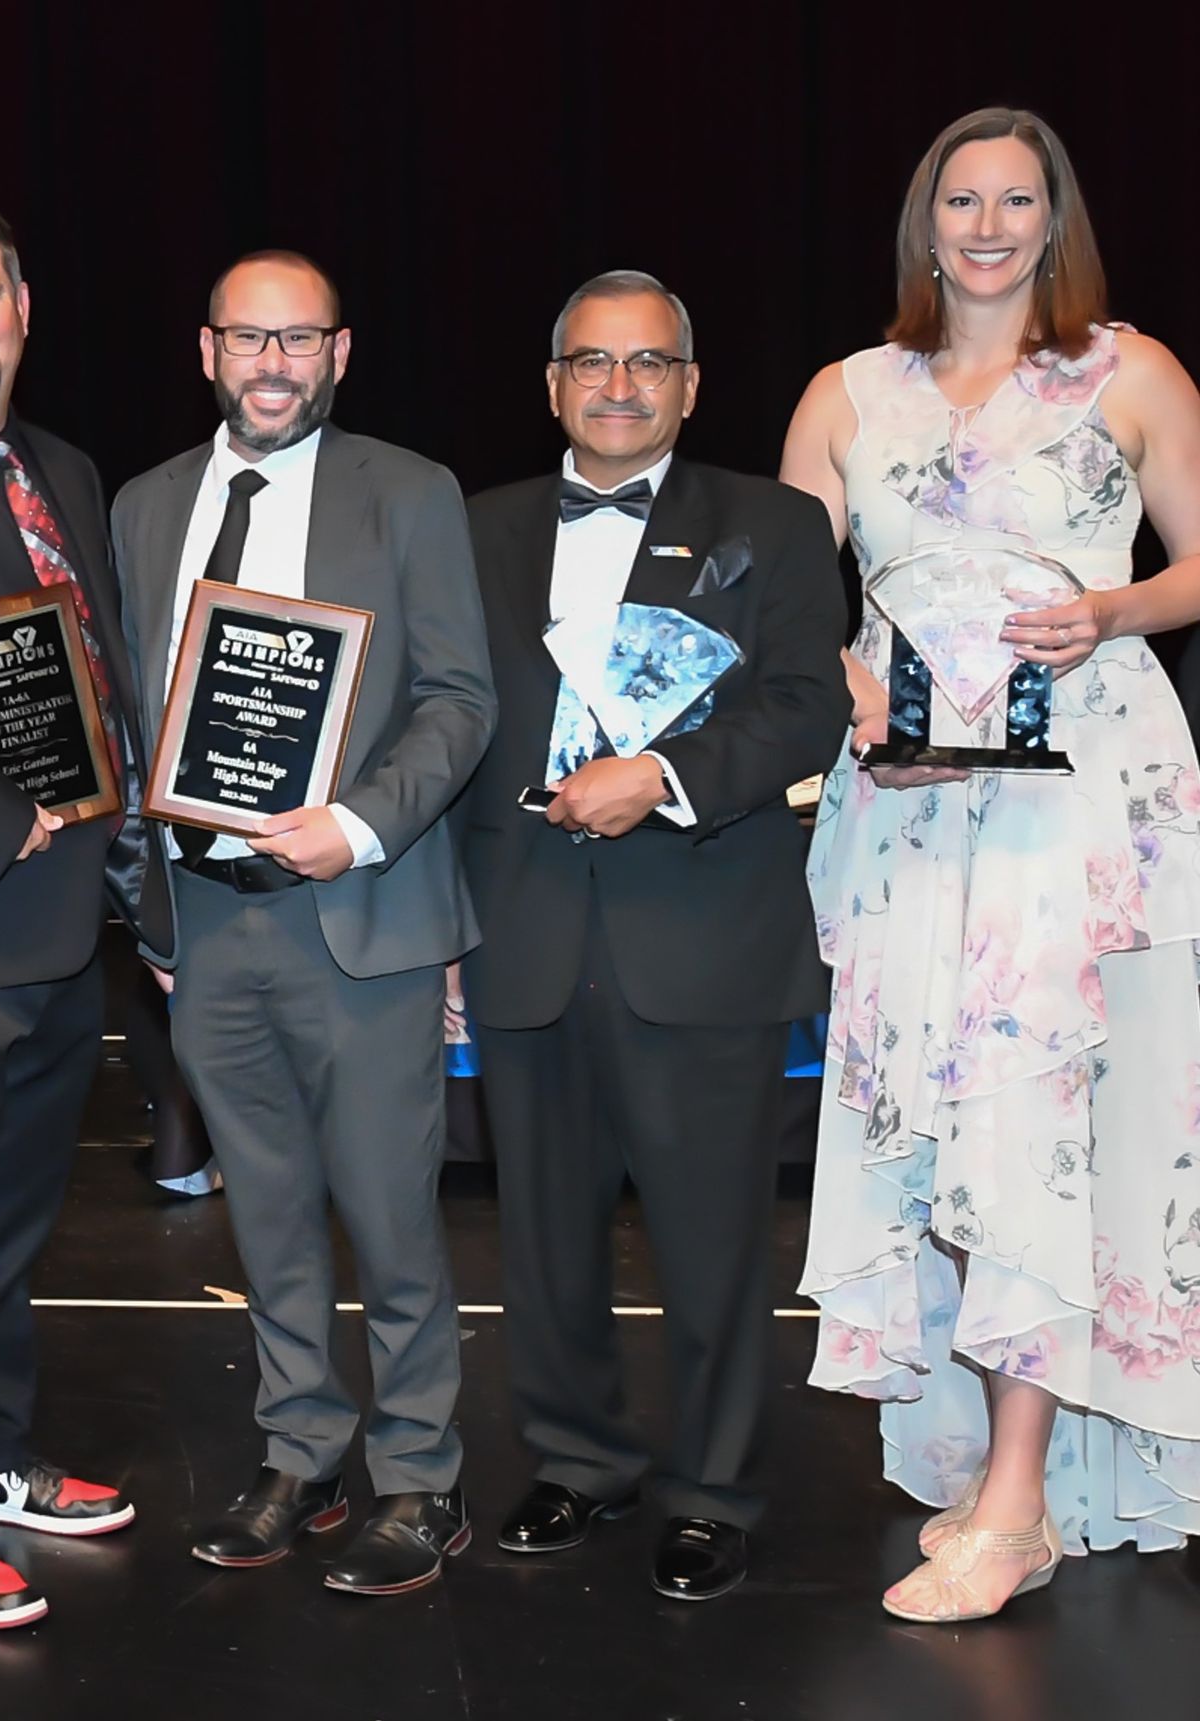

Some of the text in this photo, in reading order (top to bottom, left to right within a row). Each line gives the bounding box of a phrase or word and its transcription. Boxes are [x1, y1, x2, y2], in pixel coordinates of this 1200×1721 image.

[219, 639, 325, 672] CHAMPIONS
[250, 686, 273, 699] AIA
[212, 691, 307, 720] SPORTSMANSHIP
[4, 720, 26, 733] THE
[27, 712, 56, 727] YEAR
[235, 711, 278, 727] AWARD
[0, 727, 49, 749] FINALIST
[242, 741, 257, 754] 6A
[206, 750, 288, 779] Mountain Ridge
[26, 775, 49, 788] High
[50, 765, 80, 782] School
[212, 768, 275, 791] High School
